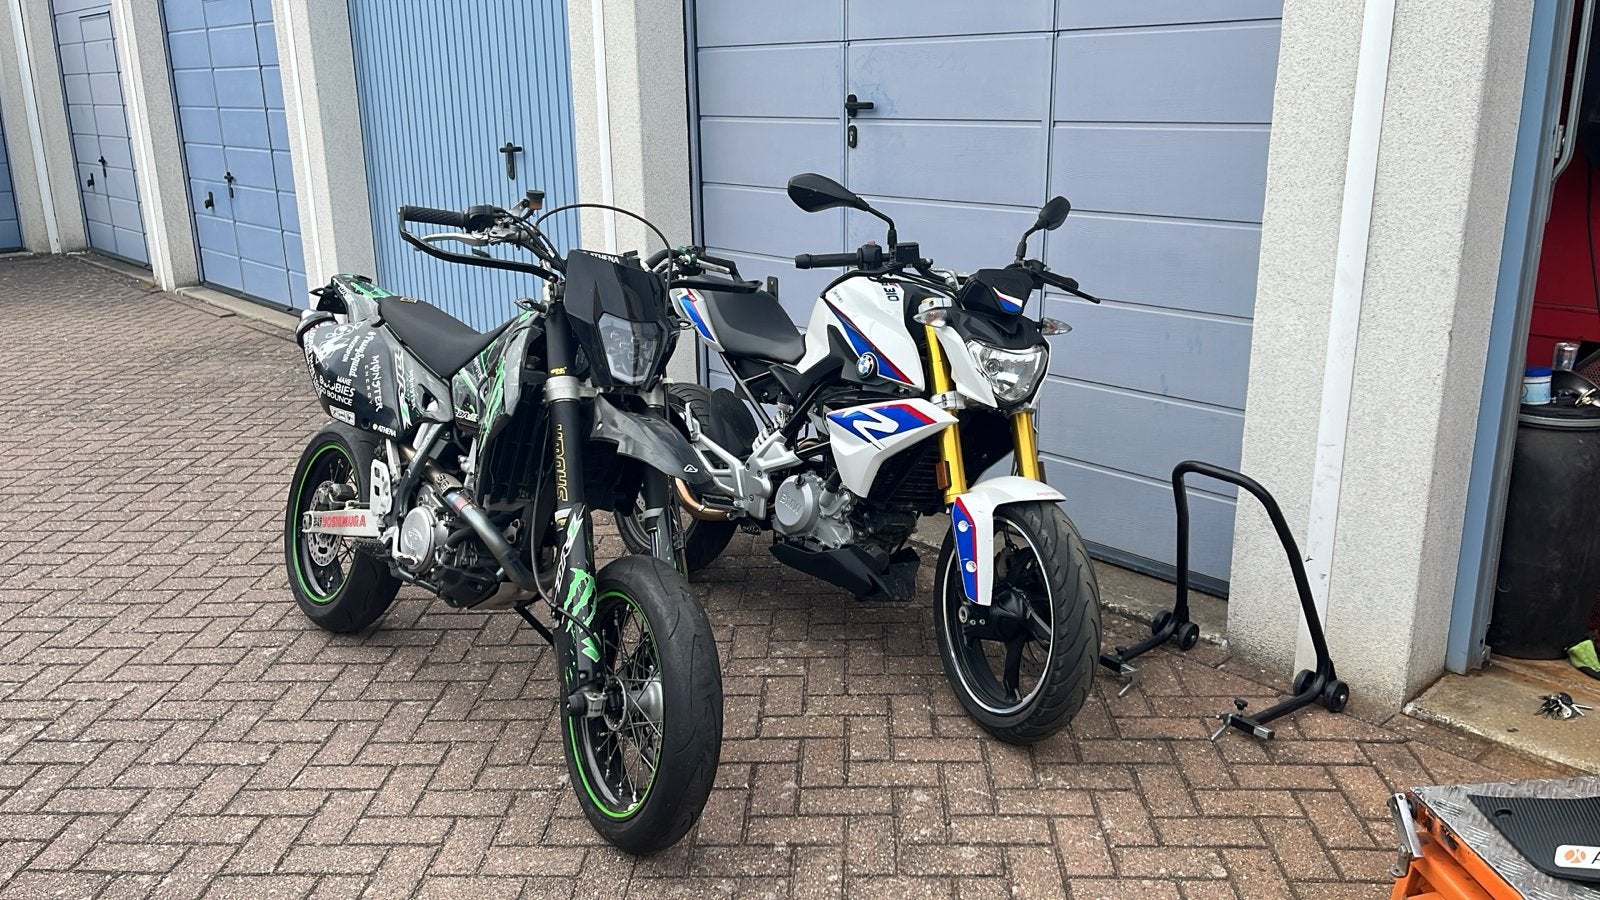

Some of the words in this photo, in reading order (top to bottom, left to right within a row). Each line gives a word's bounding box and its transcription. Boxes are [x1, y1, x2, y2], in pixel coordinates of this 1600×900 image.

[336, 376, 353, 386] MAKE
[370, 354, 384, 412] MONSTER
[326, 391, 354, 406] BOUNCE
[322, 514, 367, 528] YOSHIMURA
